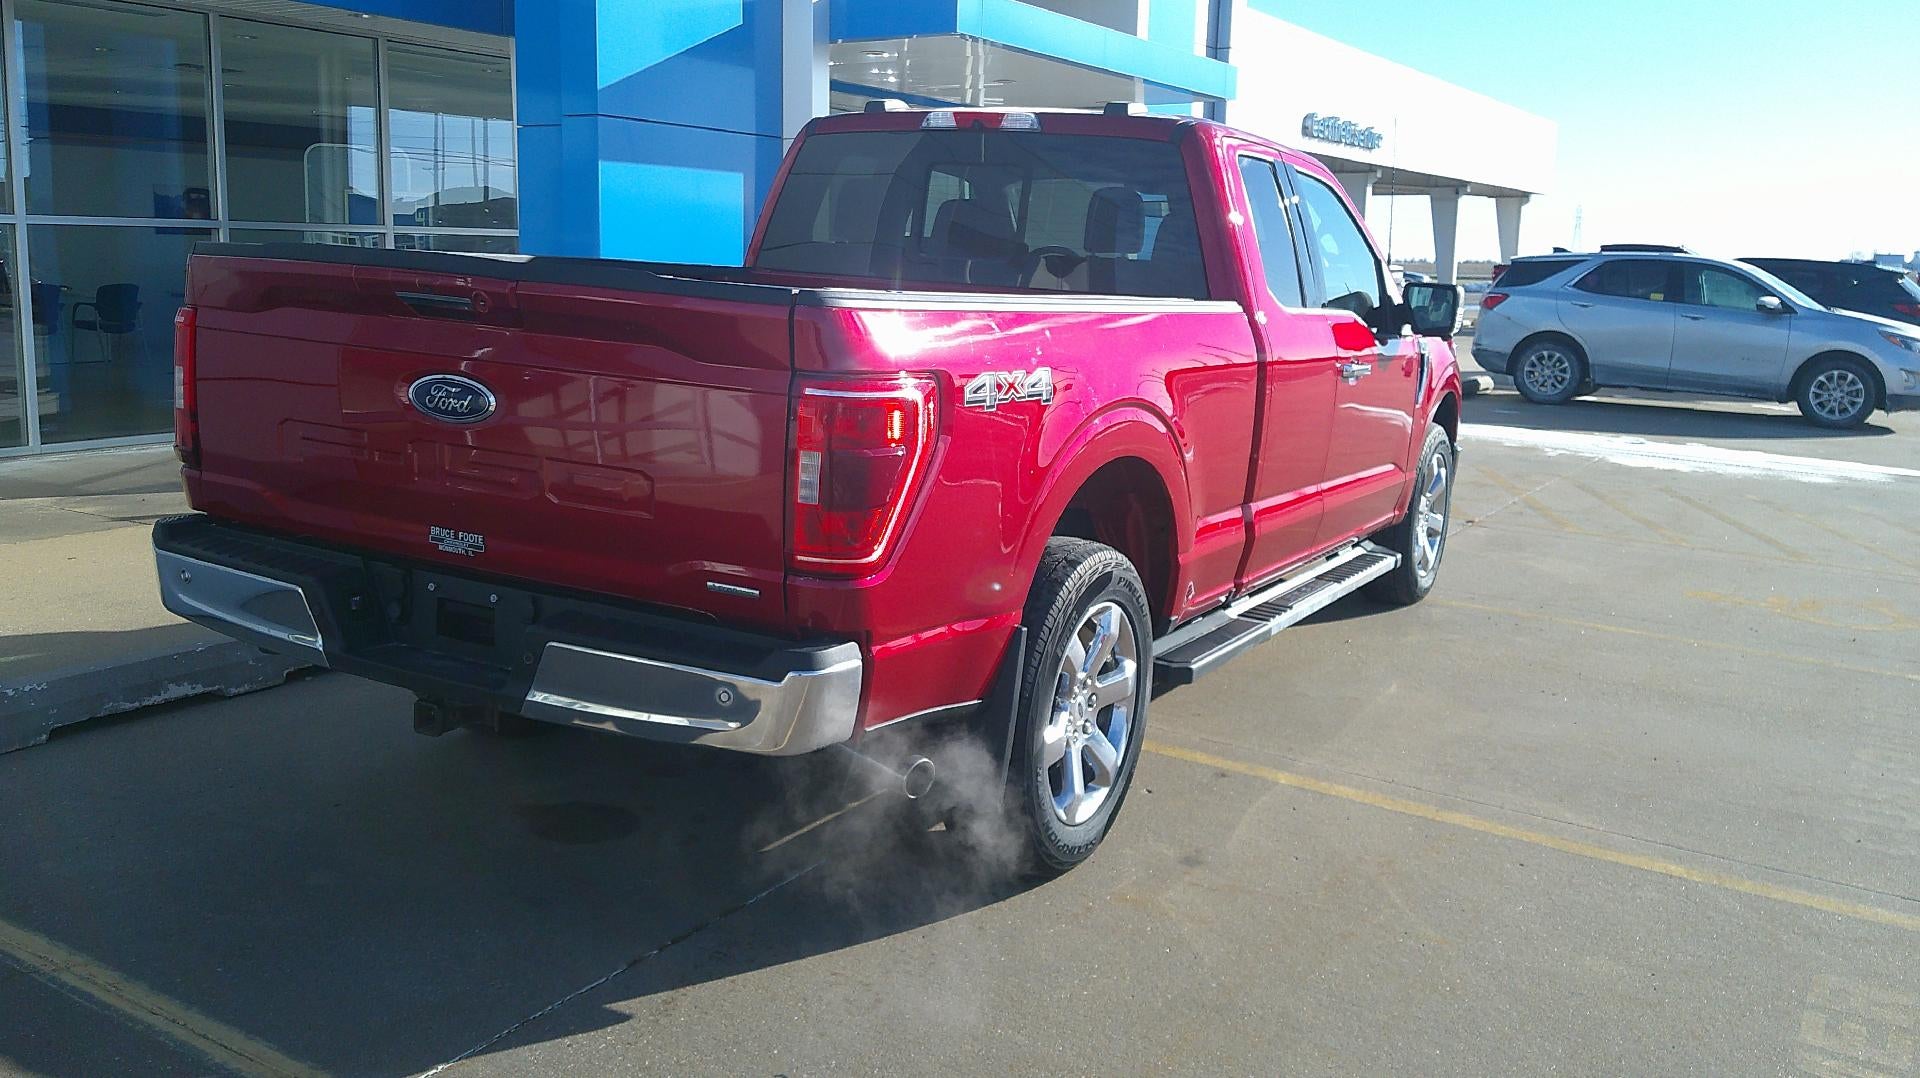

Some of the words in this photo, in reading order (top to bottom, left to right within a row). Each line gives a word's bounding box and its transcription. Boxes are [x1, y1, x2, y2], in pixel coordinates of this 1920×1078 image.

[425, 383, 473, 413] Ford
[430, 526, 455, 539] BRUCE
[458, 531, 484, 545] FOOTE
[1116, 576, 1148, 618] PIRELLI
